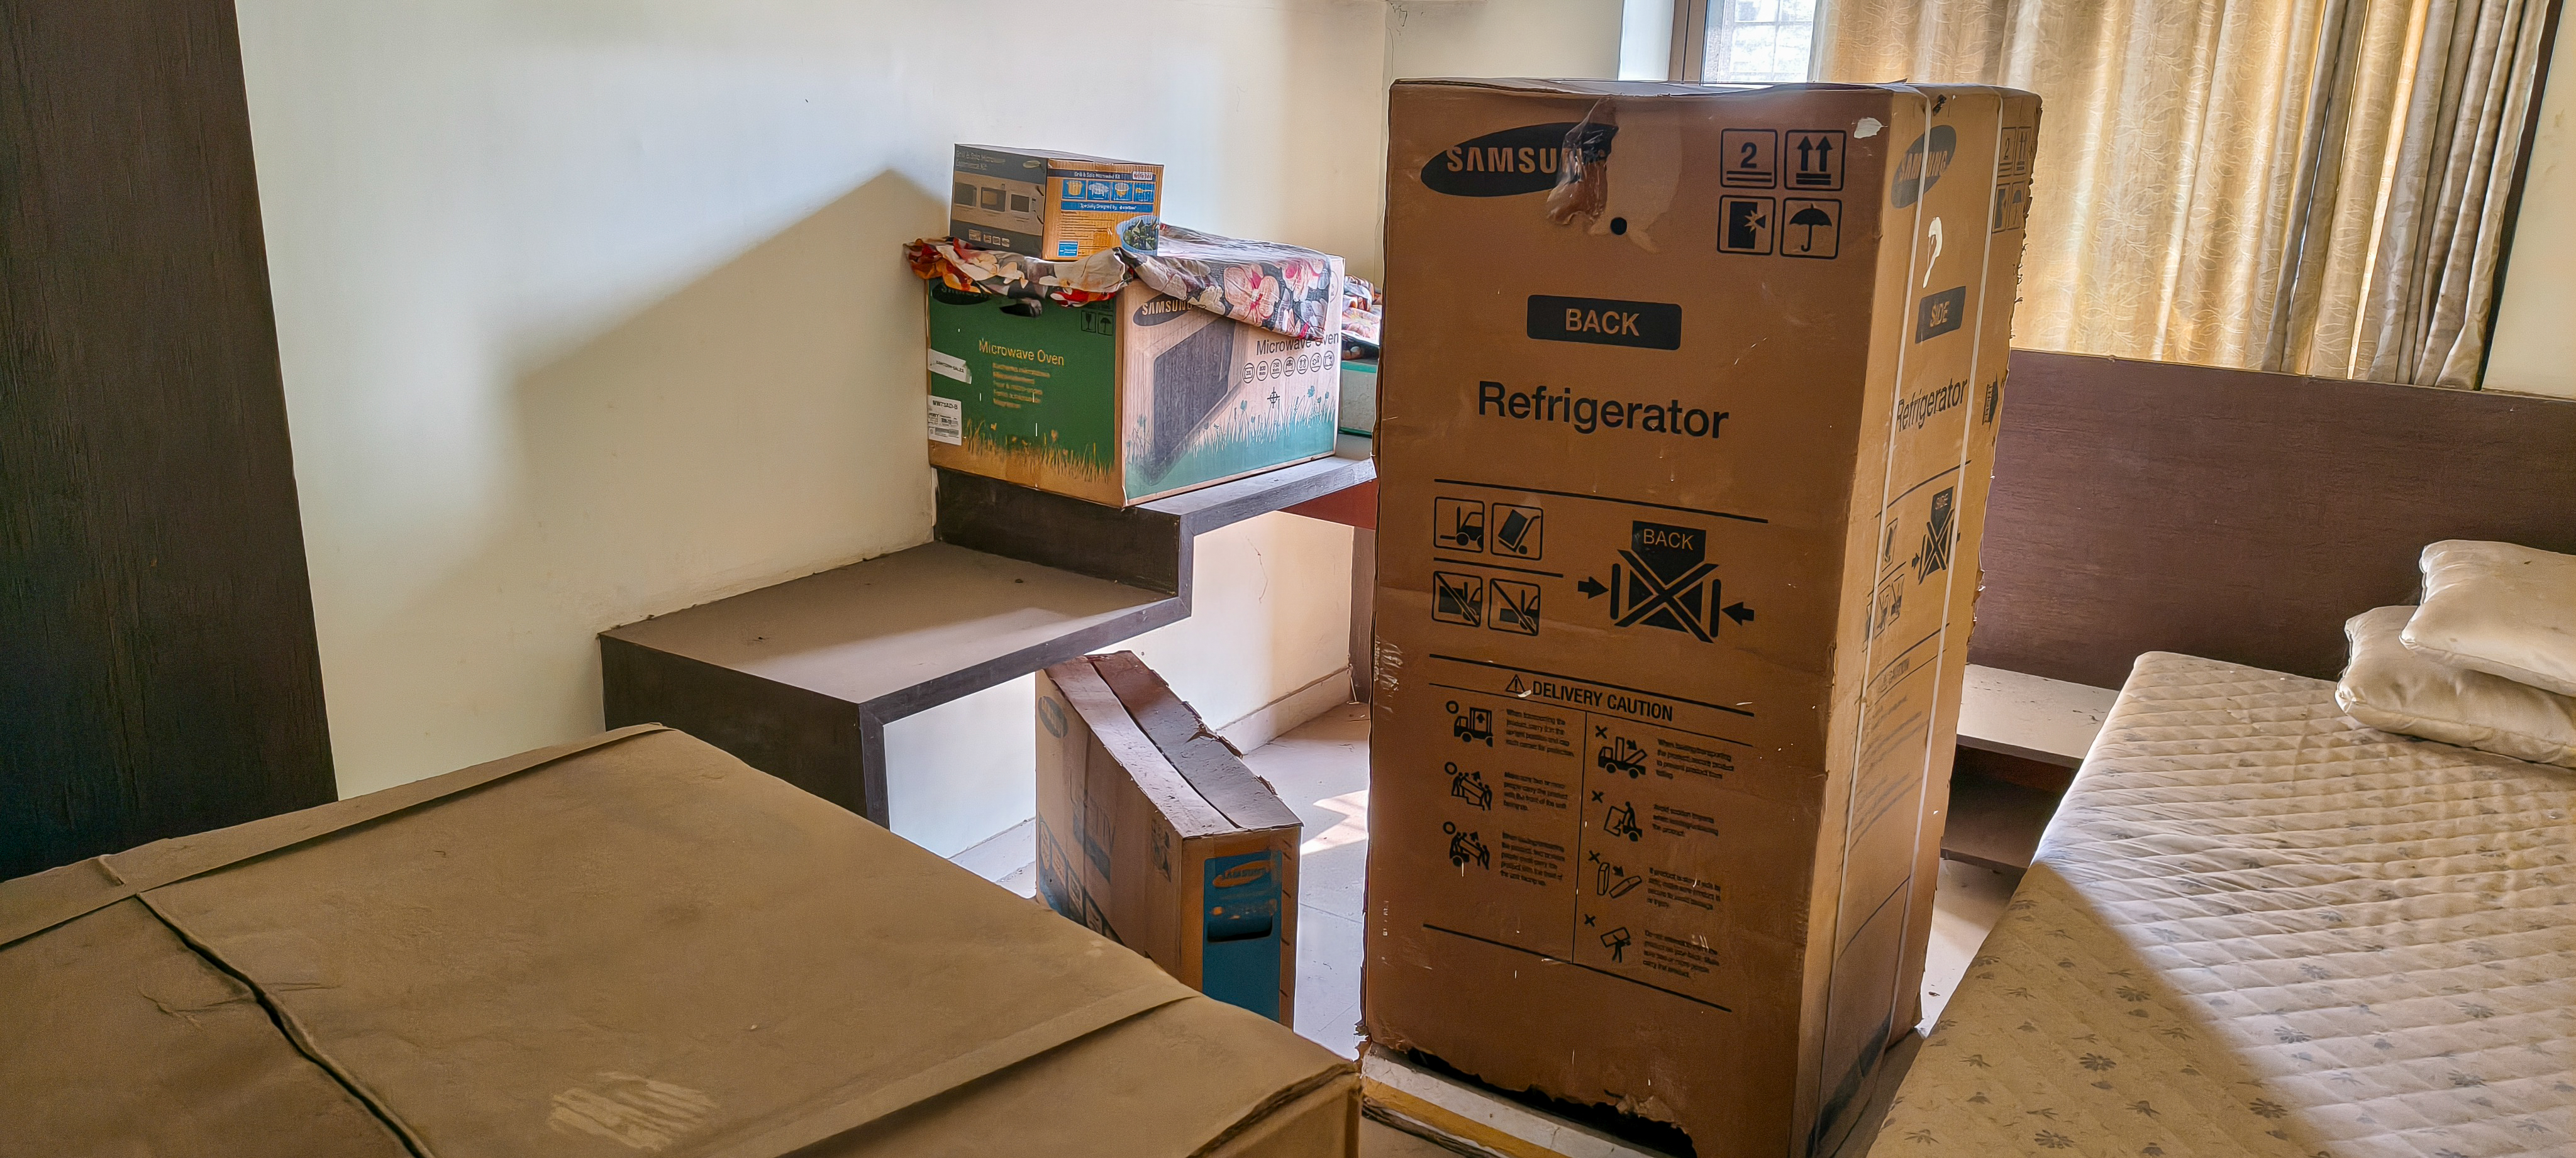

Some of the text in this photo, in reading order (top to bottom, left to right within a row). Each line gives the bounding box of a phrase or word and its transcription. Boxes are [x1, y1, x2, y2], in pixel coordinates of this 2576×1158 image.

[1740, 141, 1757, 168] 2
[2004, 136, 2010, 158] 2
[1447, 146, 1606, 177] SAMSUN
[1565, 308, 1640, 337] BACK
[1929, 301, 1950, 328] SIDE
[979, 338, 1064, 366] Microwave Oven
[1257, 339, 1312, 356] Microwave
[1479, 380, 1729, 439] Refrigerator
[1896, 378, 1968, 433] Refrigerator
[1643, 528, 1694, 551] BACK
[1532, 680, 1673, 722] DELIVERY CAUTION
